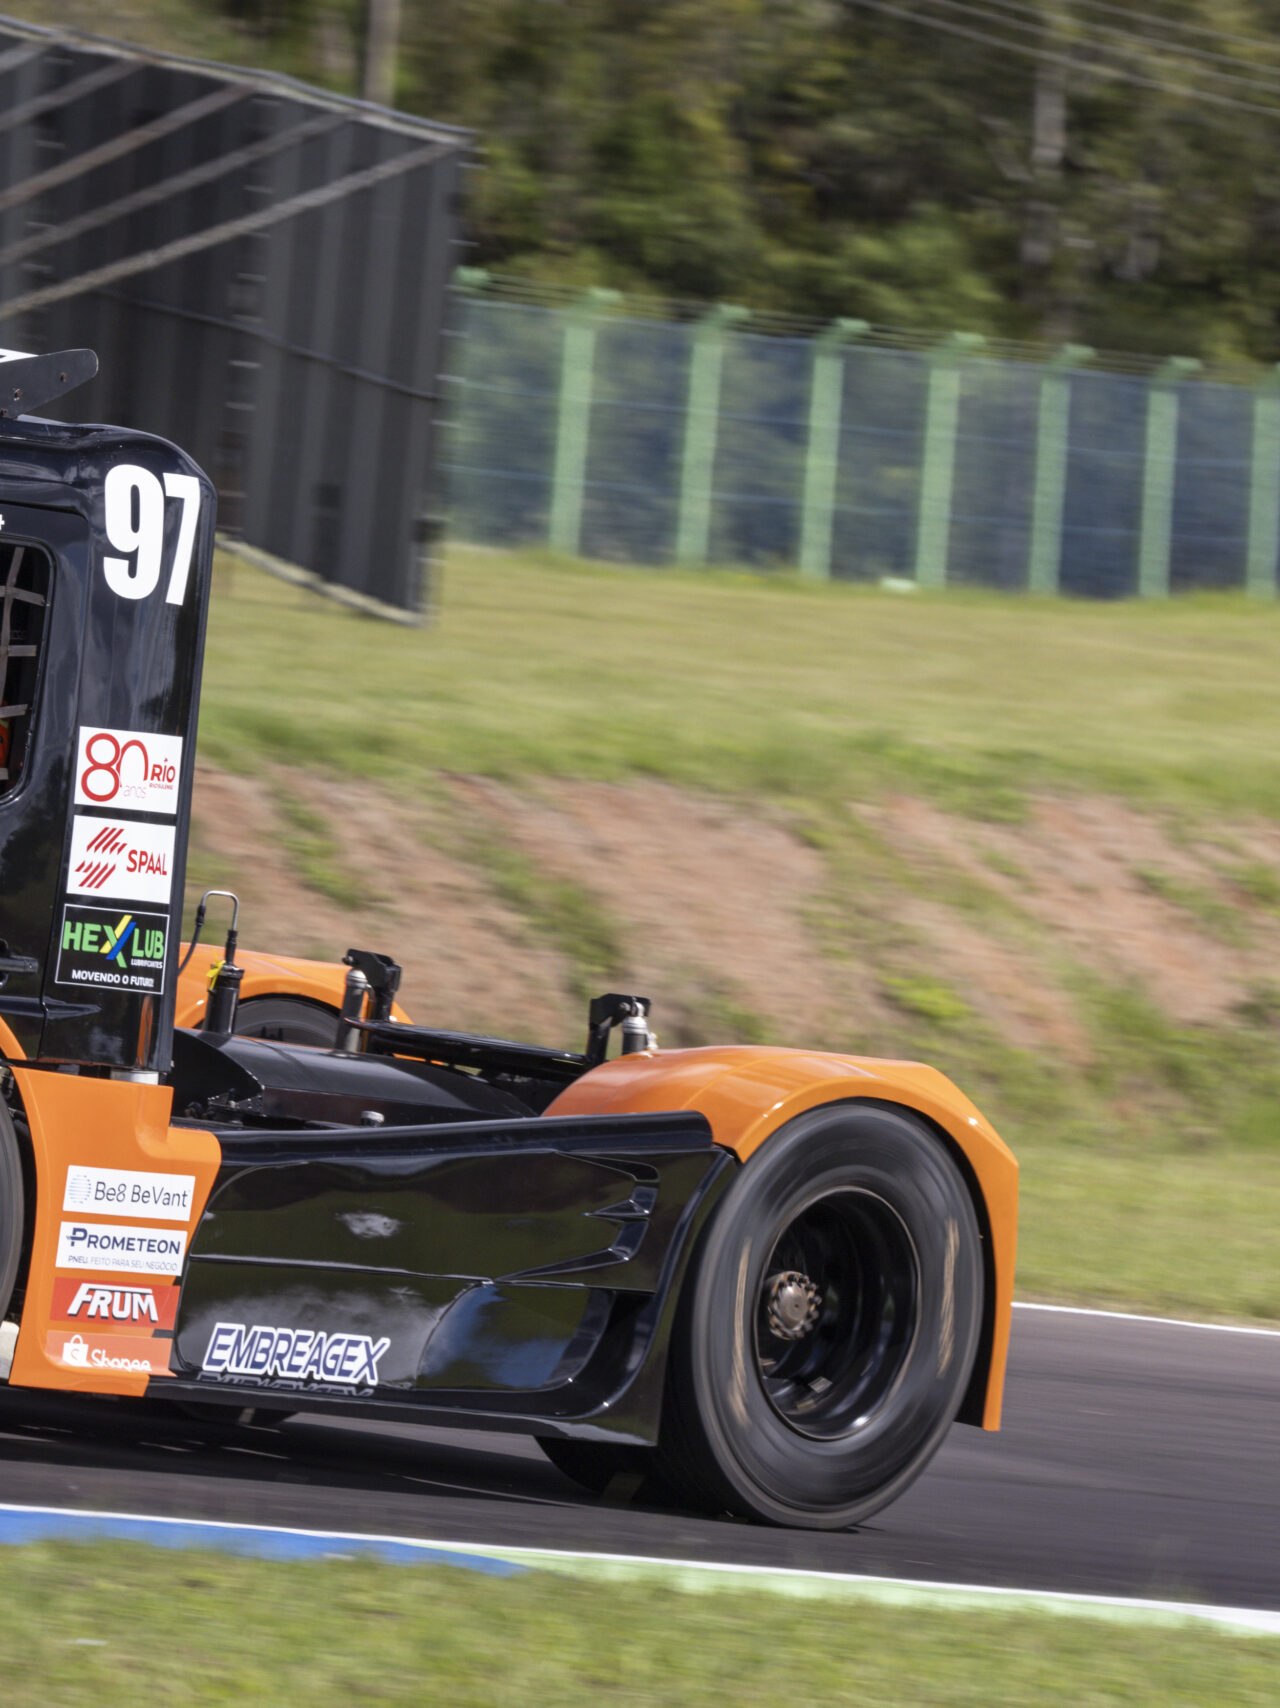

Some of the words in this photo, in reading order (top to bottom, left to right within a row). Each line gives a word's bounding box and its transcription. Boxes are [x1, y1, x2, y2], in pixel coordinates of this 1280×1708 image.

[103, 464, 201, 606] 97
[126, 850, 167, 876] SPAAL
[72, 969, 120, 983] MOVENDO
[122, 974, 129, 984] O
[94, 1181, 127, 1203] Be8
[131, 1184, 188, 1208] BeVant
[66, 1228, 181, 1255] PROMETEON
[67, 1283, 158, 1322] FRUM
[203, 1323, 390, 1385] EMBREAGEX
